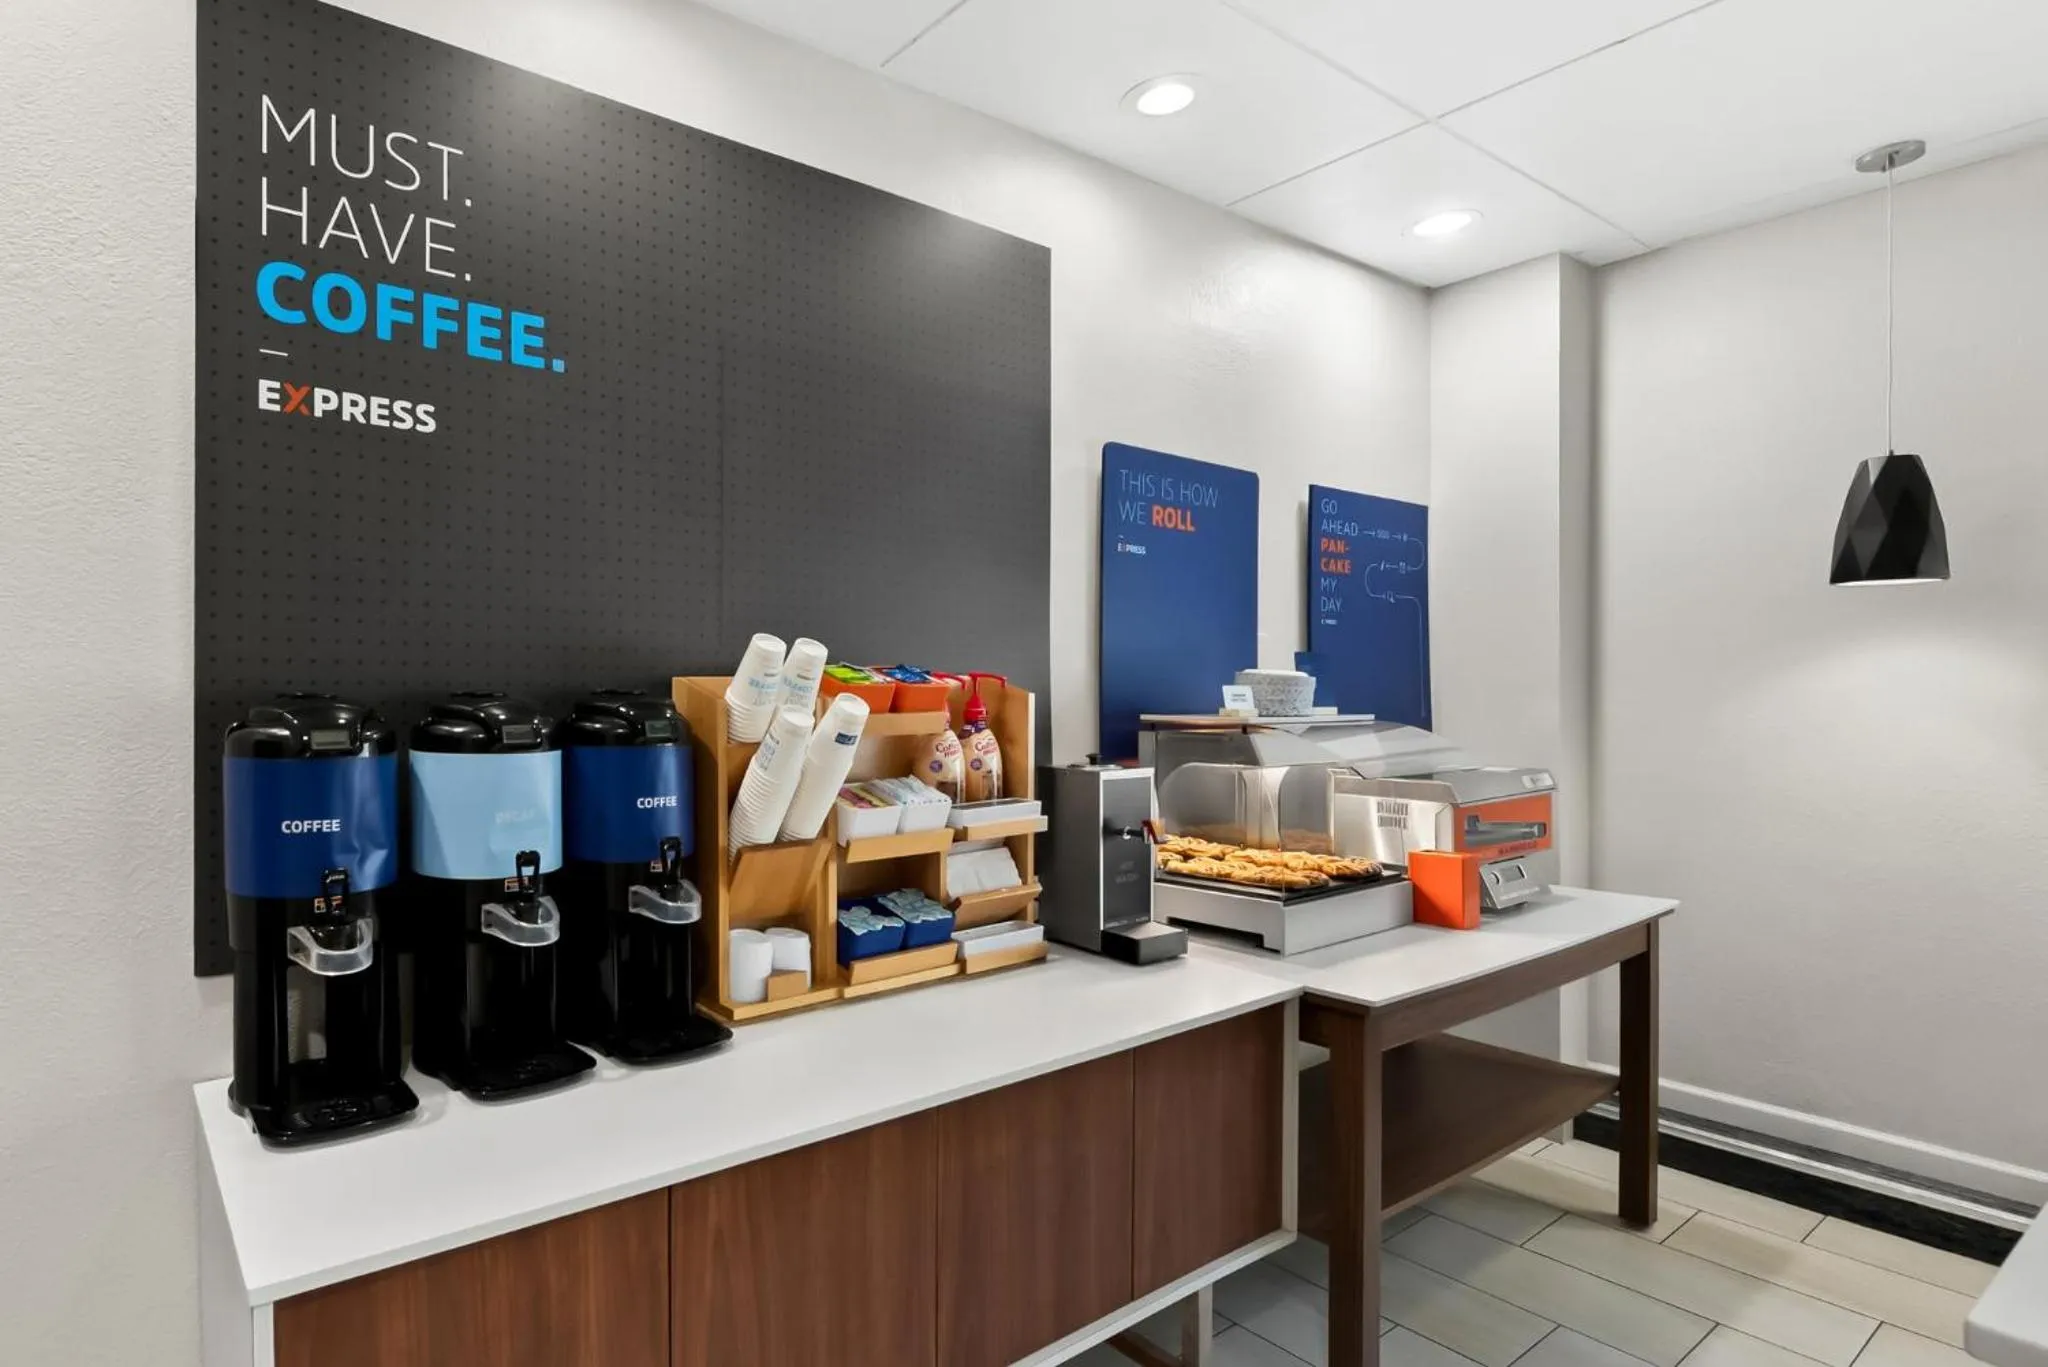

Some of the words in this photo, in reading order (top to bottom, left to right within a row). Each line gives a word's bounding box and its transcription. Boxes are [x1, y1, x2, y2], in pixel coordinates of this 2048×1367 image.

[262, 94, 472, 207] MUST.
[262, 176, 472, 281] HAVE.
[256, 261, 565, 373] COFFEE.
[258, 379, 437, 433] EXPRESS
[1119, 469, 1156, 498] THIS
[1161, 477, 1175, 501] IS
[1180, 480, 1219, 508] HOW
[1321, 498, 1338, 515] GO
[1118, 500, 1147, 525] WE
[1152, 505, 1196, 532] ROLL
[1321, 519, 1359, 536] AHEAD
[1321, 538, 1350, 554] PAN-
[1320, 558, 1352, 574] CAKE
[1321, 577, 1338, 593] MY
[1321, 596, 1342, 612] DAY
[637, 795, 678, 809] COFFEE
[281, 819, 341, 834] COFFEE
